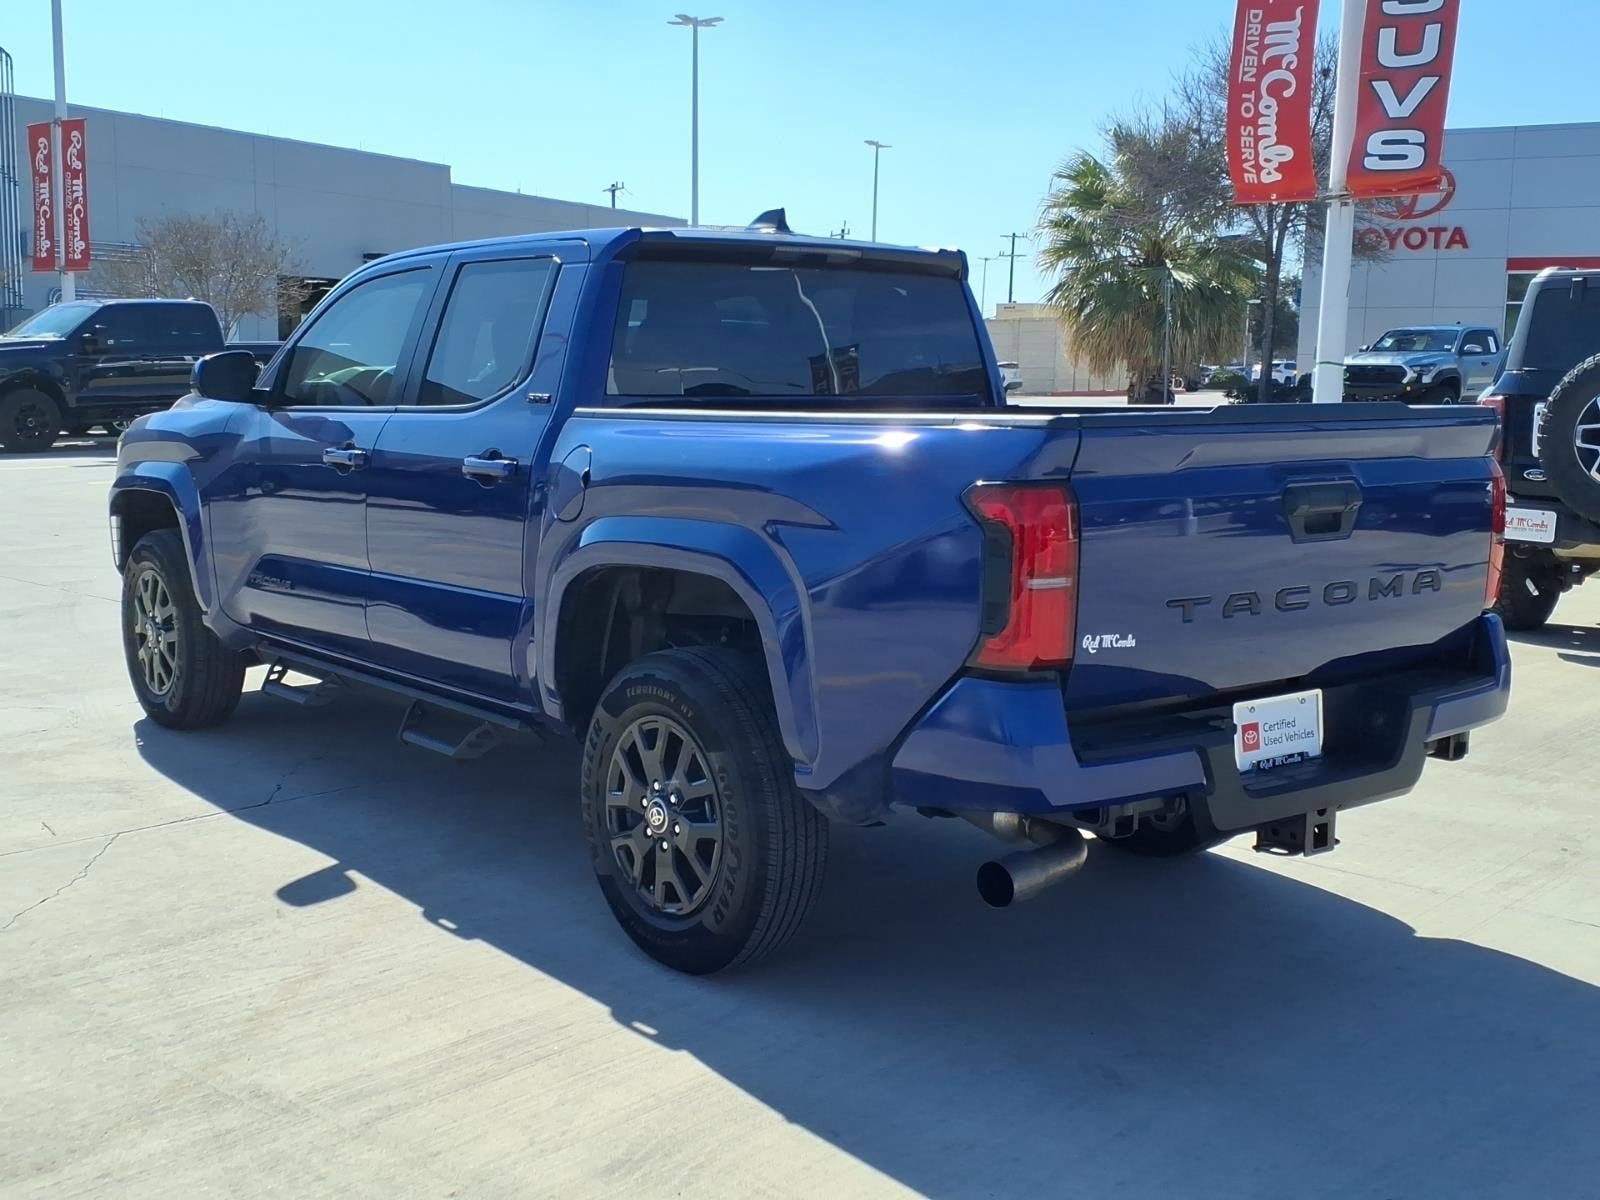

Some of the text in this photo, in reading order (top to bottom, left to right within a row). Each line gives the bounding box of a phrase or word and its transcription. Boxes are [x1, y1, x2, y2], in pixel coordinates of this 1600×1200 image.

[1241, 9, 1263, 184] DRIVEN TO SERVE
[36, 137, 49, 173] Red
[67, 130, 82, 171] Red
[67, 213, 74, 227] TO
[1358, 226, 1469, 251] OYOTA
[1166, 569, 1442, 624] TACOMA
[1082, 634, 1100, 654] Red
[1263, 717, 1297, 733] Certified
[1263, 728, 1315, 747] Used Vehicles
